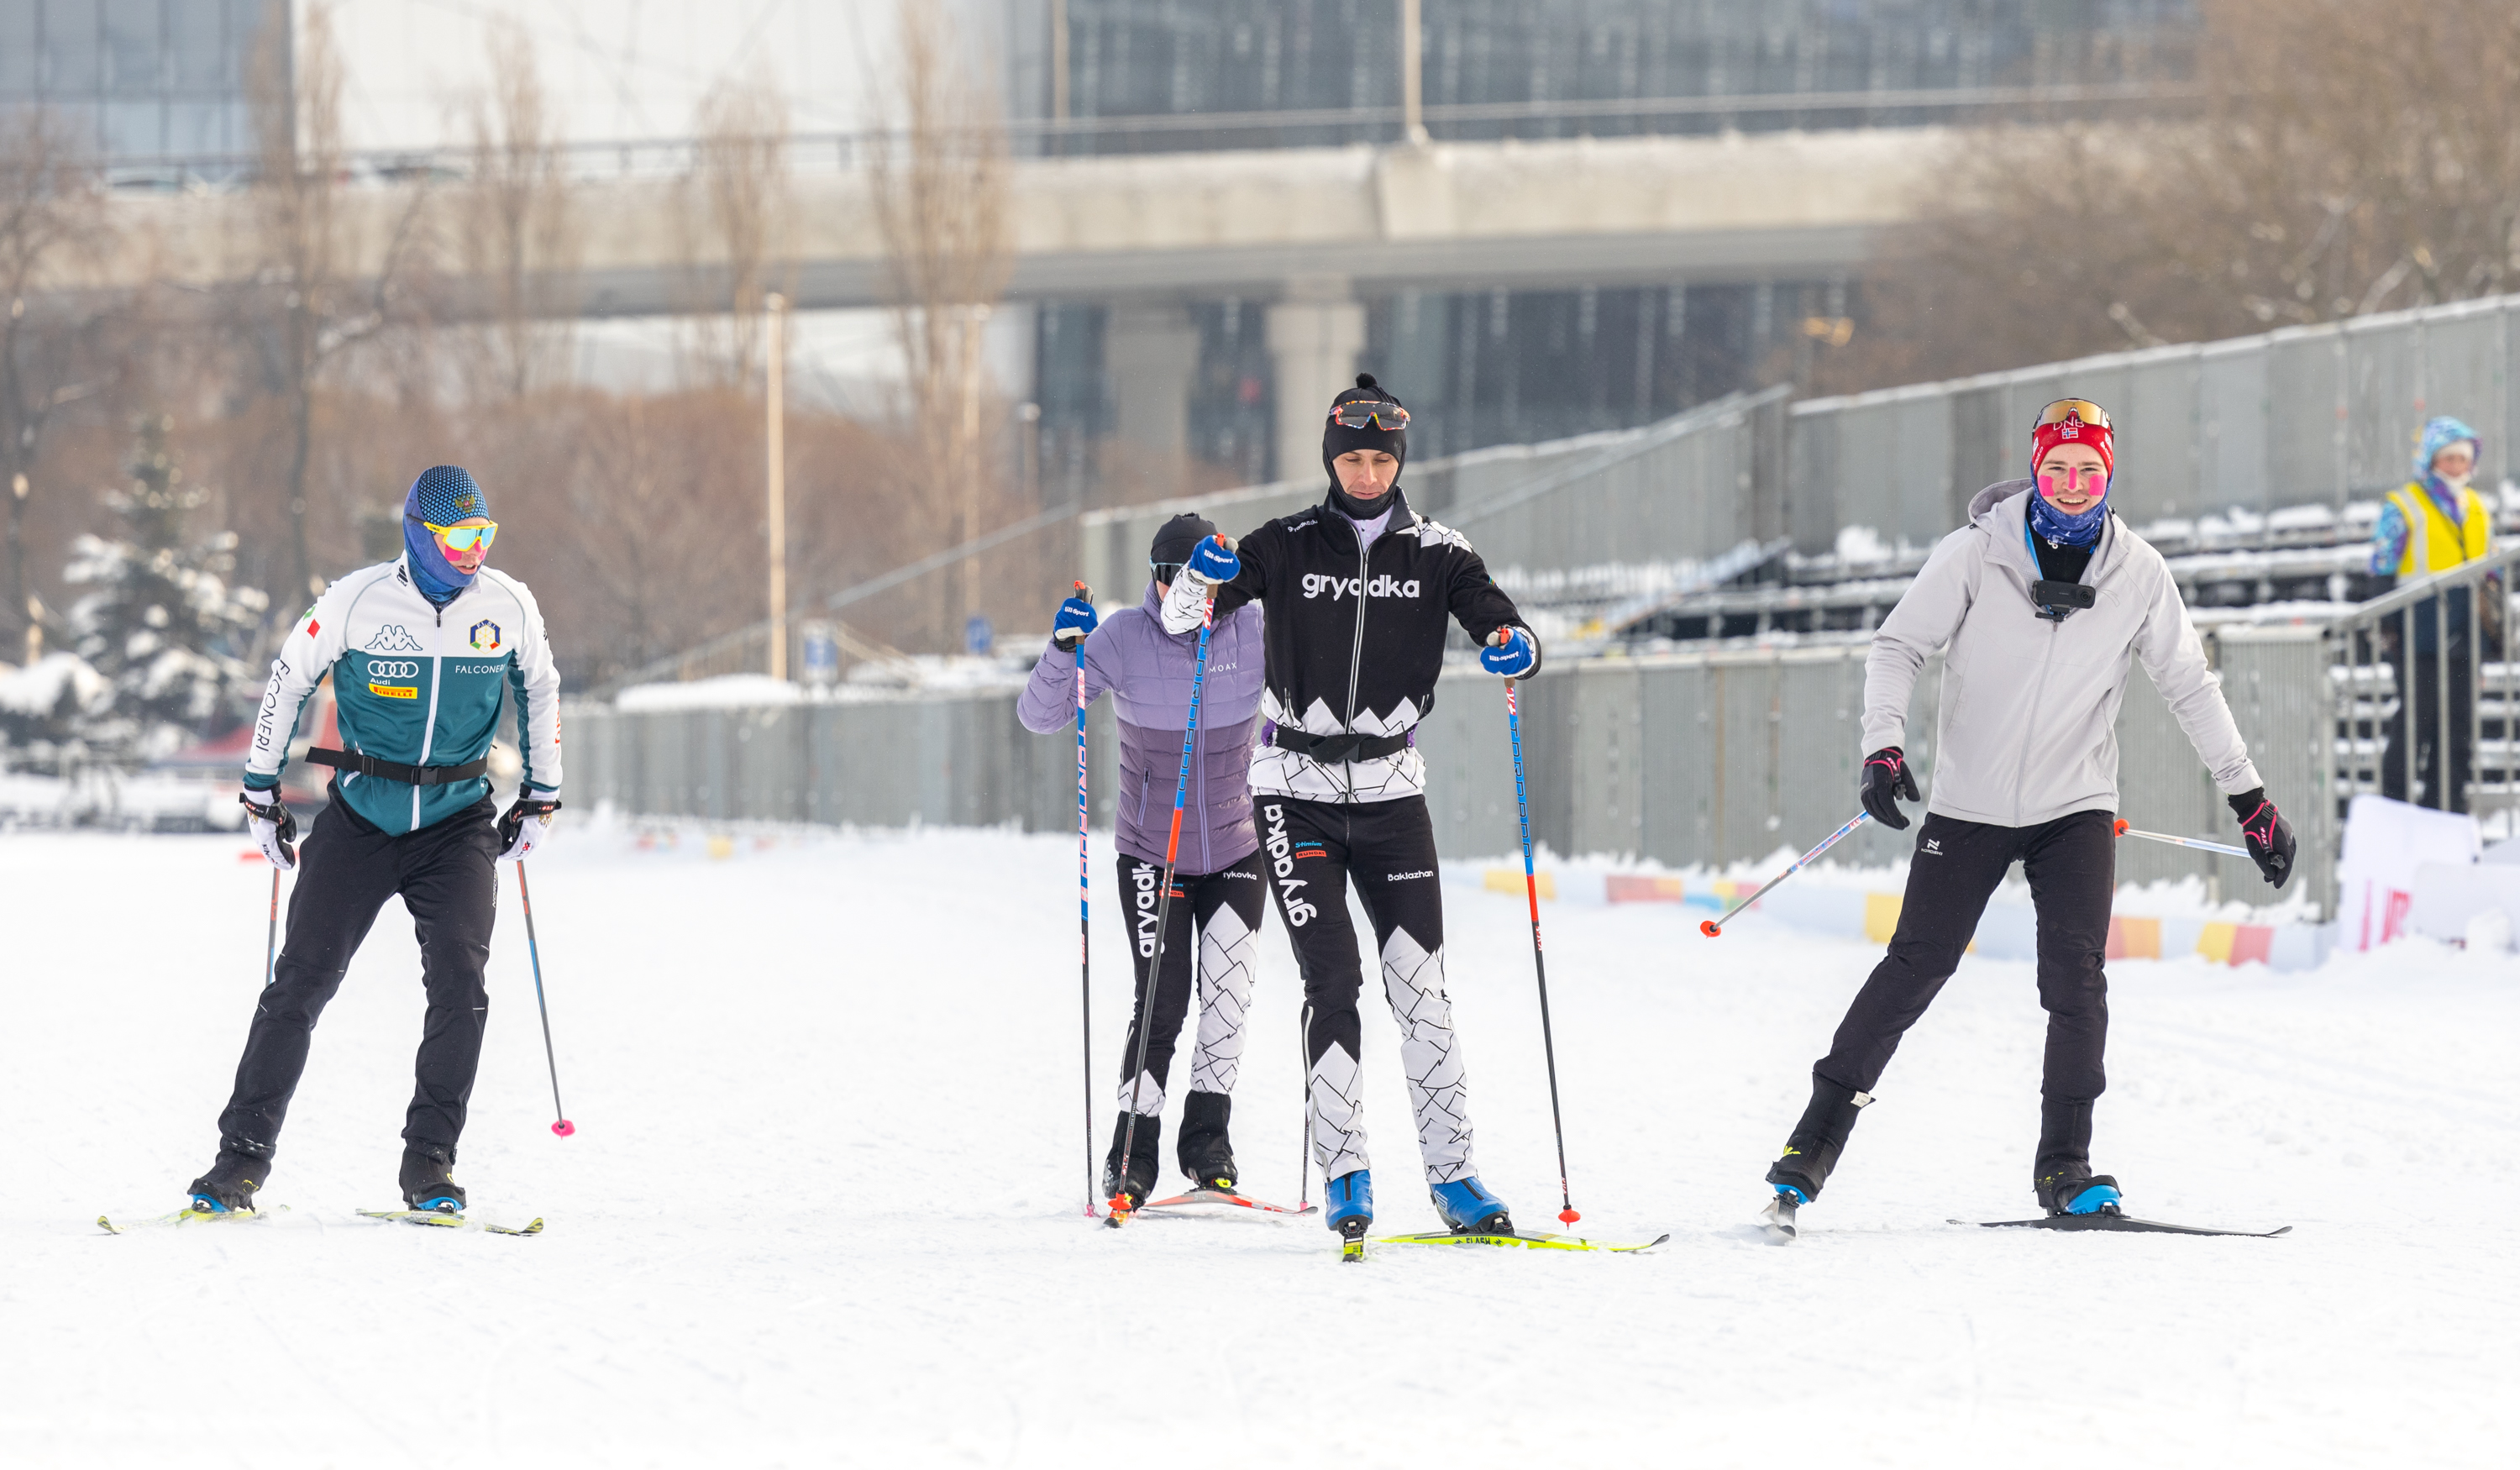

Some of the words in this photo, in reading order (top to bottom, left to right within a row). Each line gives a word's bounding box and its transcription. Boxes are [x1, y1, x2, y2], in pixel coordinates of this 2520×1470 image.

[2053, 416, 2085, 431] DNB
[1301, 573, 1420, 601] gryadka
[1209, 662, 1237, 674] MOAX
[370, 677, 391, 686] Audi
[1078, 725, 1089, 878] TORNADO
[1294, 840, 1323, 848] Stimium
[1264, 804, 1318, 927] gryadka
[1387, 870, 1434, 882] Baklazhan
[1131, 862, 1166, 958] gryadk
